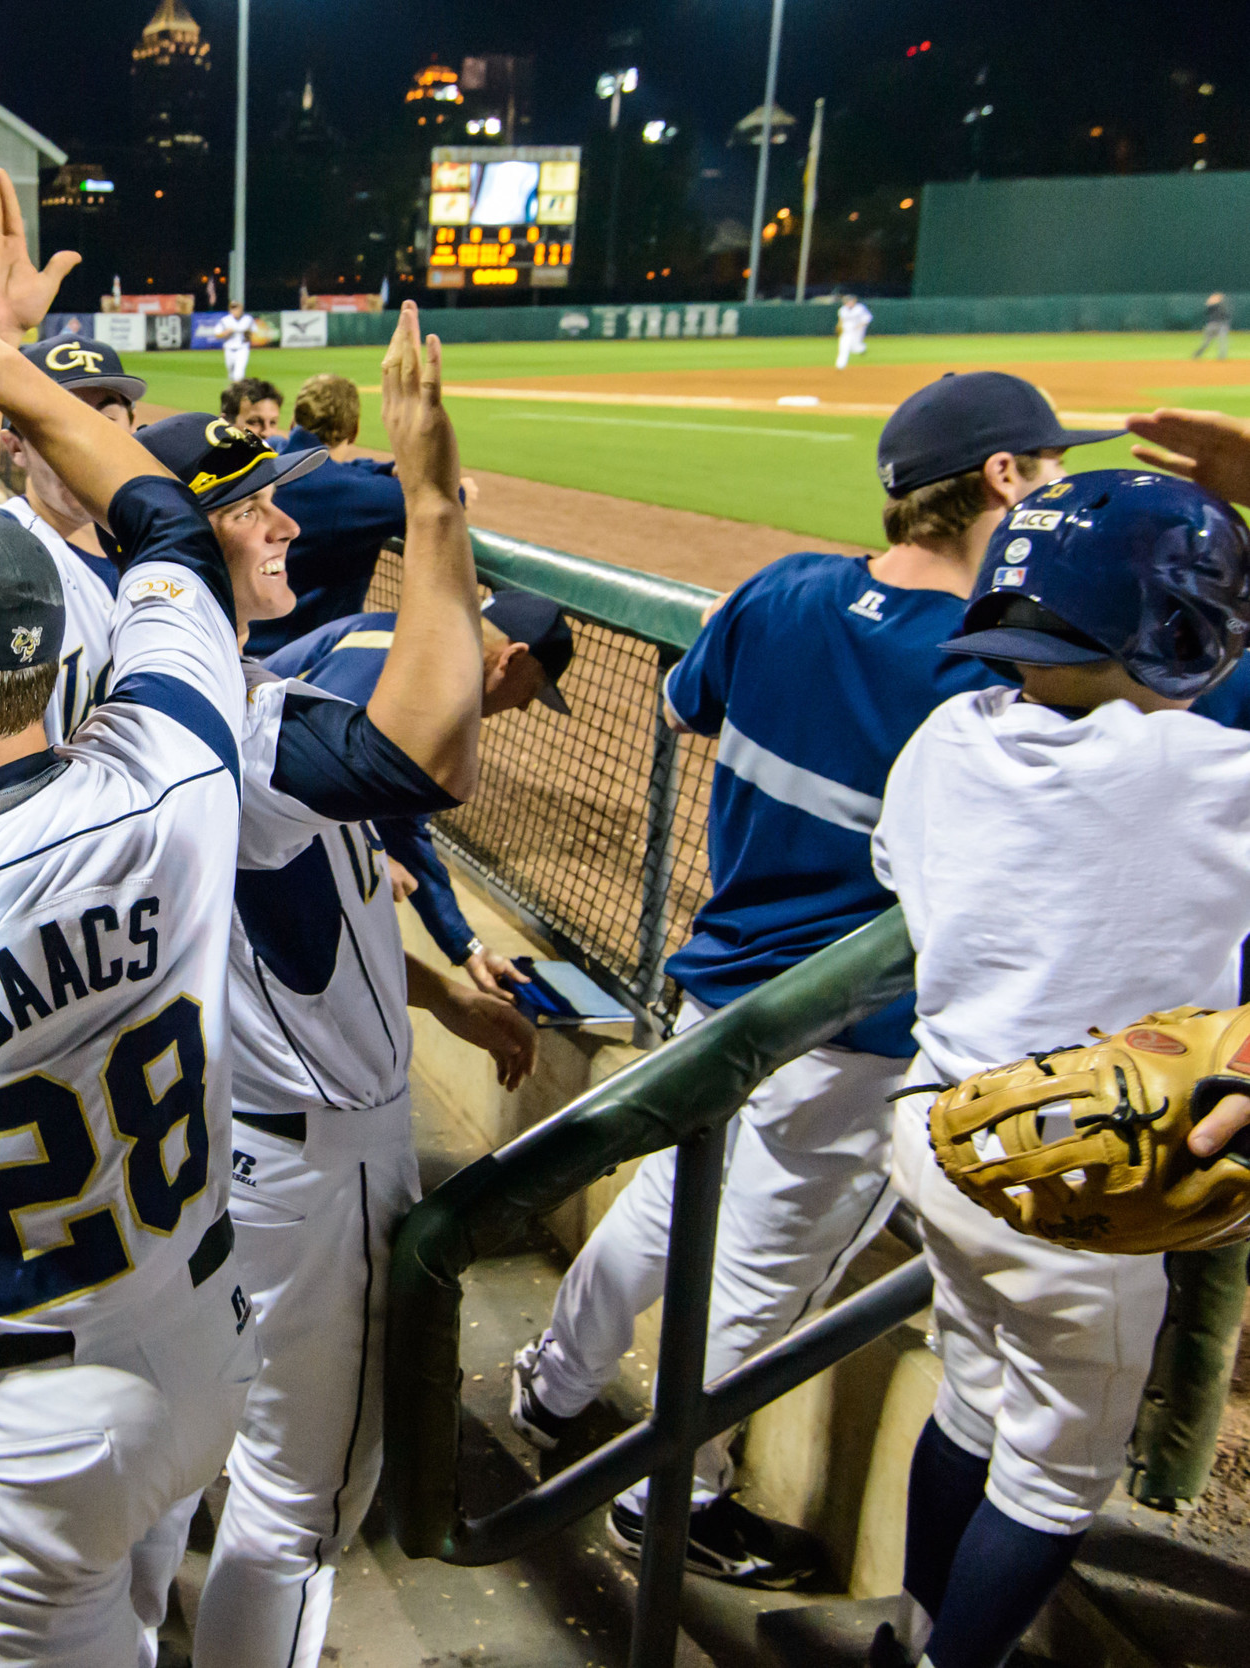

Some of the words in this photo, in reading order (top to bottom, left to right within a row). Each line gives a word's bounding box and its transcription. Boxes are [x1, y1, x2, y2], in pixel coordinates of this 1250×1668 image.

[46, 341, 104, 373] GT
[1013, 513, 1056, 527] ACC
[137, 579, 185, 599] ACC
